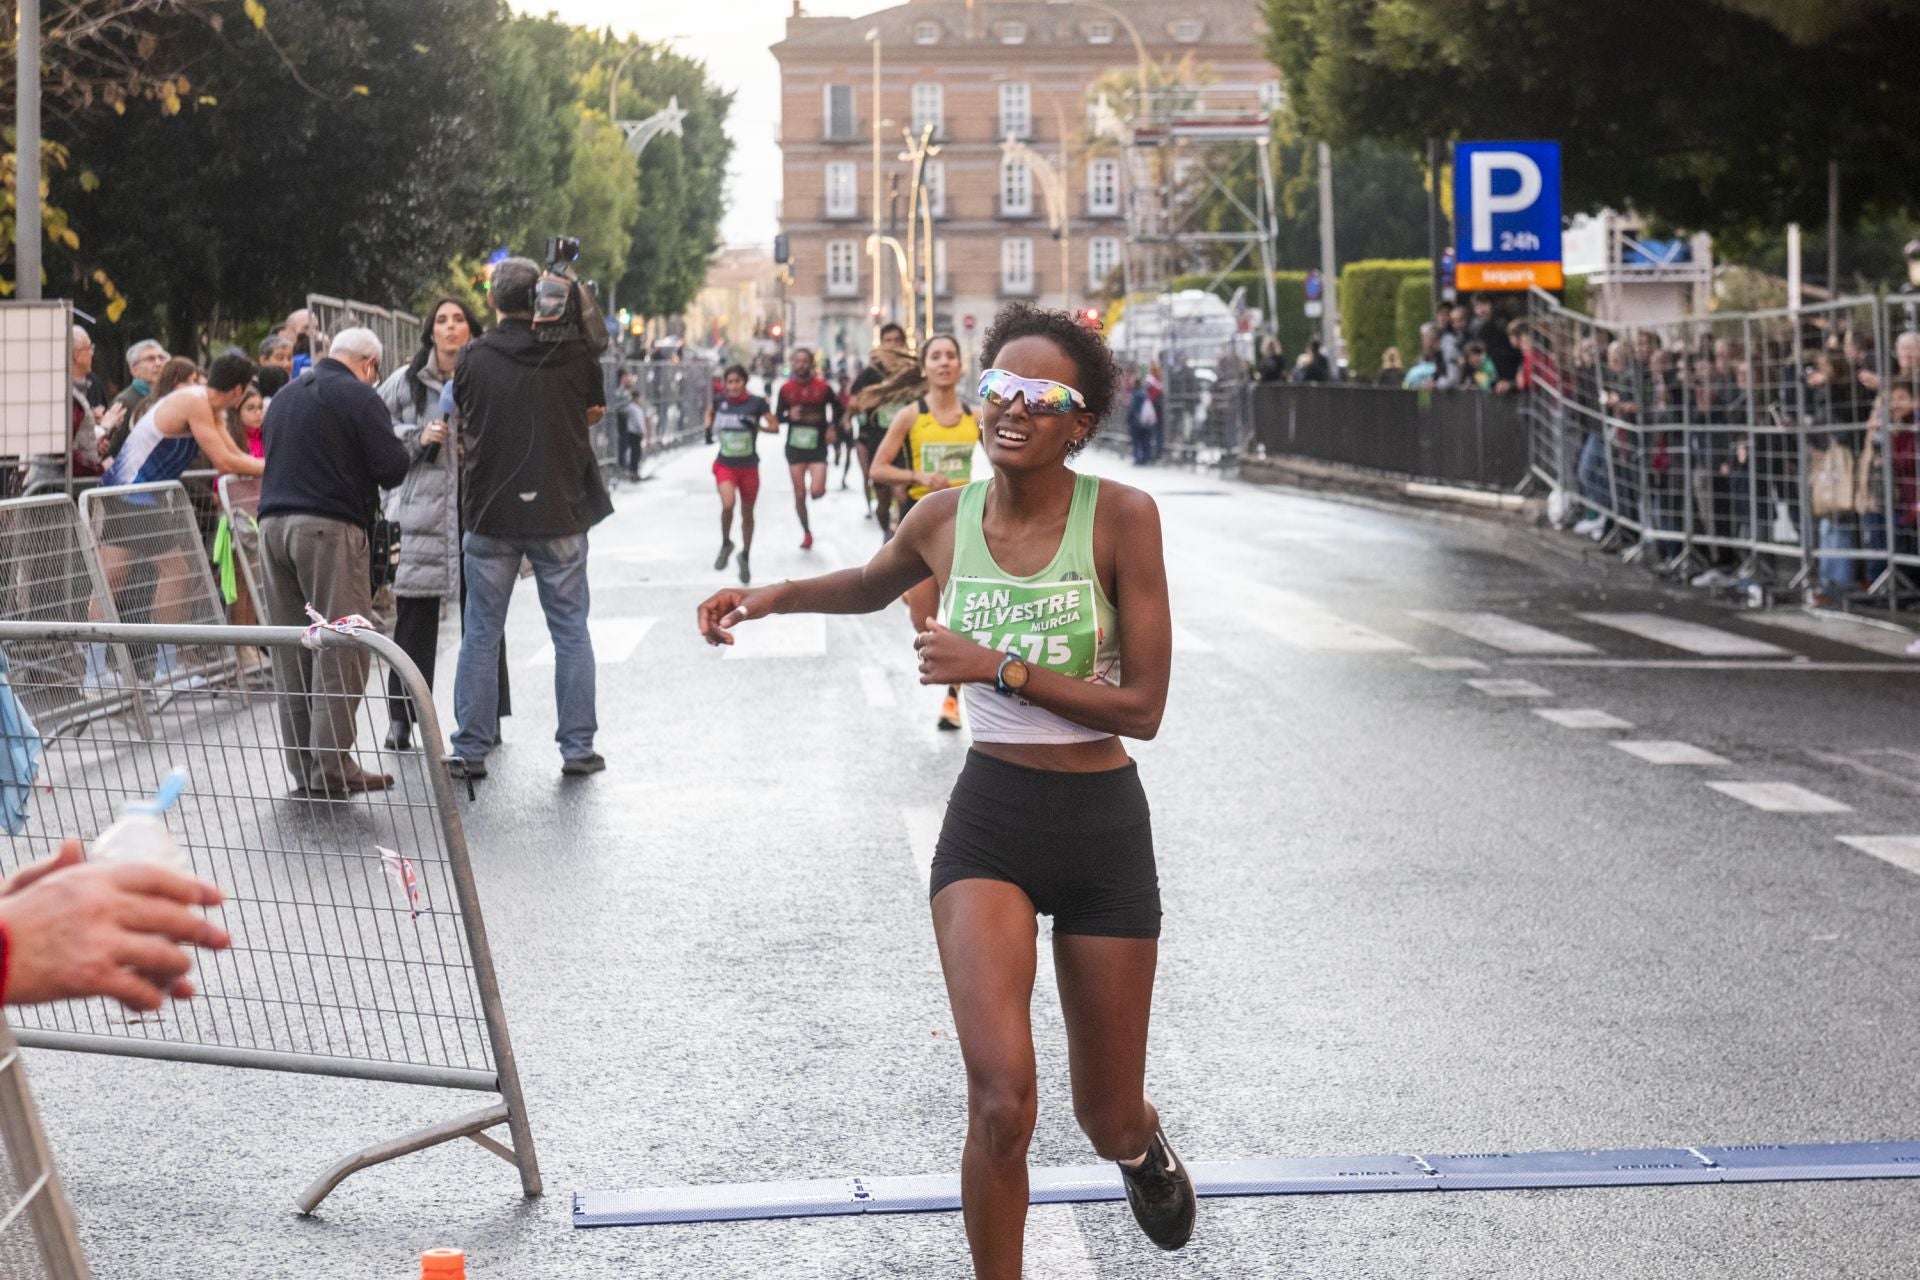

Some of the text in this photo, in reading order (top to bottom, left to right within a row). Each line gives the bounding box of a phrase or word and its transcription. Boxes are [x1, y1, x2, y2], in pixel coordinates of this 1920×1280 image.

[1470, 151, 1543, 252] P
[1500, 230, 1540, 251] 24h
[961, 589, 1081, 633] SILVESTRE
[963, 588, 1011, 613] SAN
[1030, 611, 1081, 633] MURCIA
